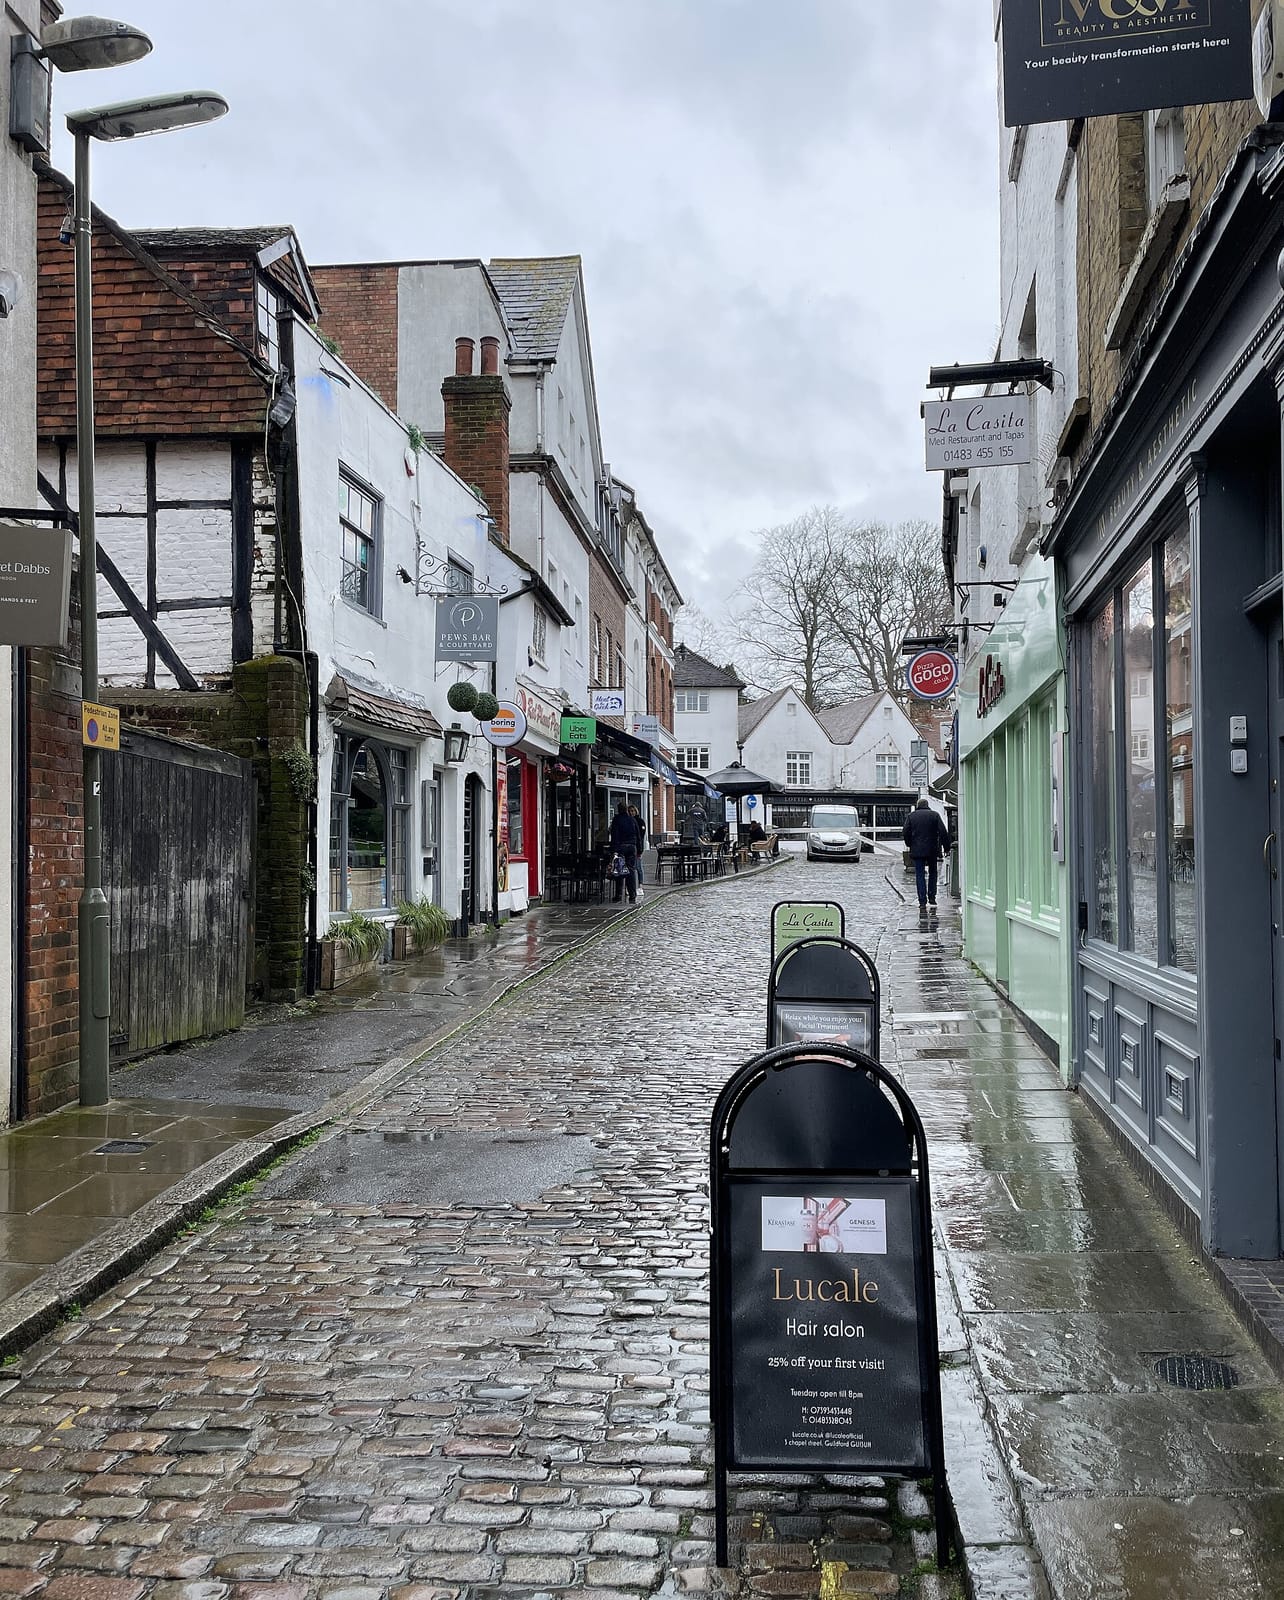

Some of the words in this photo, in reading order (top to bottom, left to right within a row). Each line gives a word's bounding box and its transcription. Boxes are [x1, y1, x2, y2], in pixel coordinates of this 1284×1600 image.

[1058, 23, 1105, 36] BEAUTY
[1128, 12, 1197, 27] AESTHETIC
[1024, 59, 1049, 69] Your
[1052, 53, 1088, 65] beauty
[1091, 44, 1168, 61] transformation
[1171, 41, 1200, 52] starts
[928, 408, 957, 434] La
[966, 404, 1024, 431] Casita
[928, 437, 945, 446] Med
[948, 433, 986, 445] Restaurant
[988, 432, 1002, 441] and
[1005, 431, 1025, 440] Tapas
[943, 448, 972, 461] 01483
[976, 447, 993, 459] 455
[998, 445, 1014, 457] 155
[1109, 473, 1135, 523] BEAUTY
[1138, 462, 1144, 480] &
[1147, 378, 1198, 469] AESTHETIC
[14, 562, 50, 574] Dabbs
[441, 633, 468, 641] PEWS
[472, 633, 491, 641] BAR
[917, 662, 934, 671] Pizza
[913, 663, 951, 684] GOGO
[933, 675, 950, 685] co.uk
[84, 704, 107, 717] Pedestrian
[108, 710, 118, 720] Zone
[490, 718, 516, 728] boring
[570, 724, 587, 732] Uber
[108, 726, 116, 735] any
[616, 771, 630, 783] boring
[782, 912, 799, 926] La
[803, 912, 834, 927] Casita
[785, 1013, 801, 1021] Relax
[771, 1267, 879, 1304] Lucale
[786, 1317, 818, 1336] Hair
[823, 1319, 865, 1338] salon
[767, 1357, 788, 1368] 25%
[790, 1356, 806, 1367] off
[808, 1358, 833, 1369] your
[834, 1357, 857, 1369] first
[858, 1358, 885, 1370] visit!
[790, 1388, 818, 1398] Tuesdays
[820, 1391, 838, 1399] open
[839, 1390, 847, 1398] till
[848, 1390, 863, 1399] 8pm
[801, 1406, 809, 1414] M:
[824, 1440, 850, 1448] Guildford
